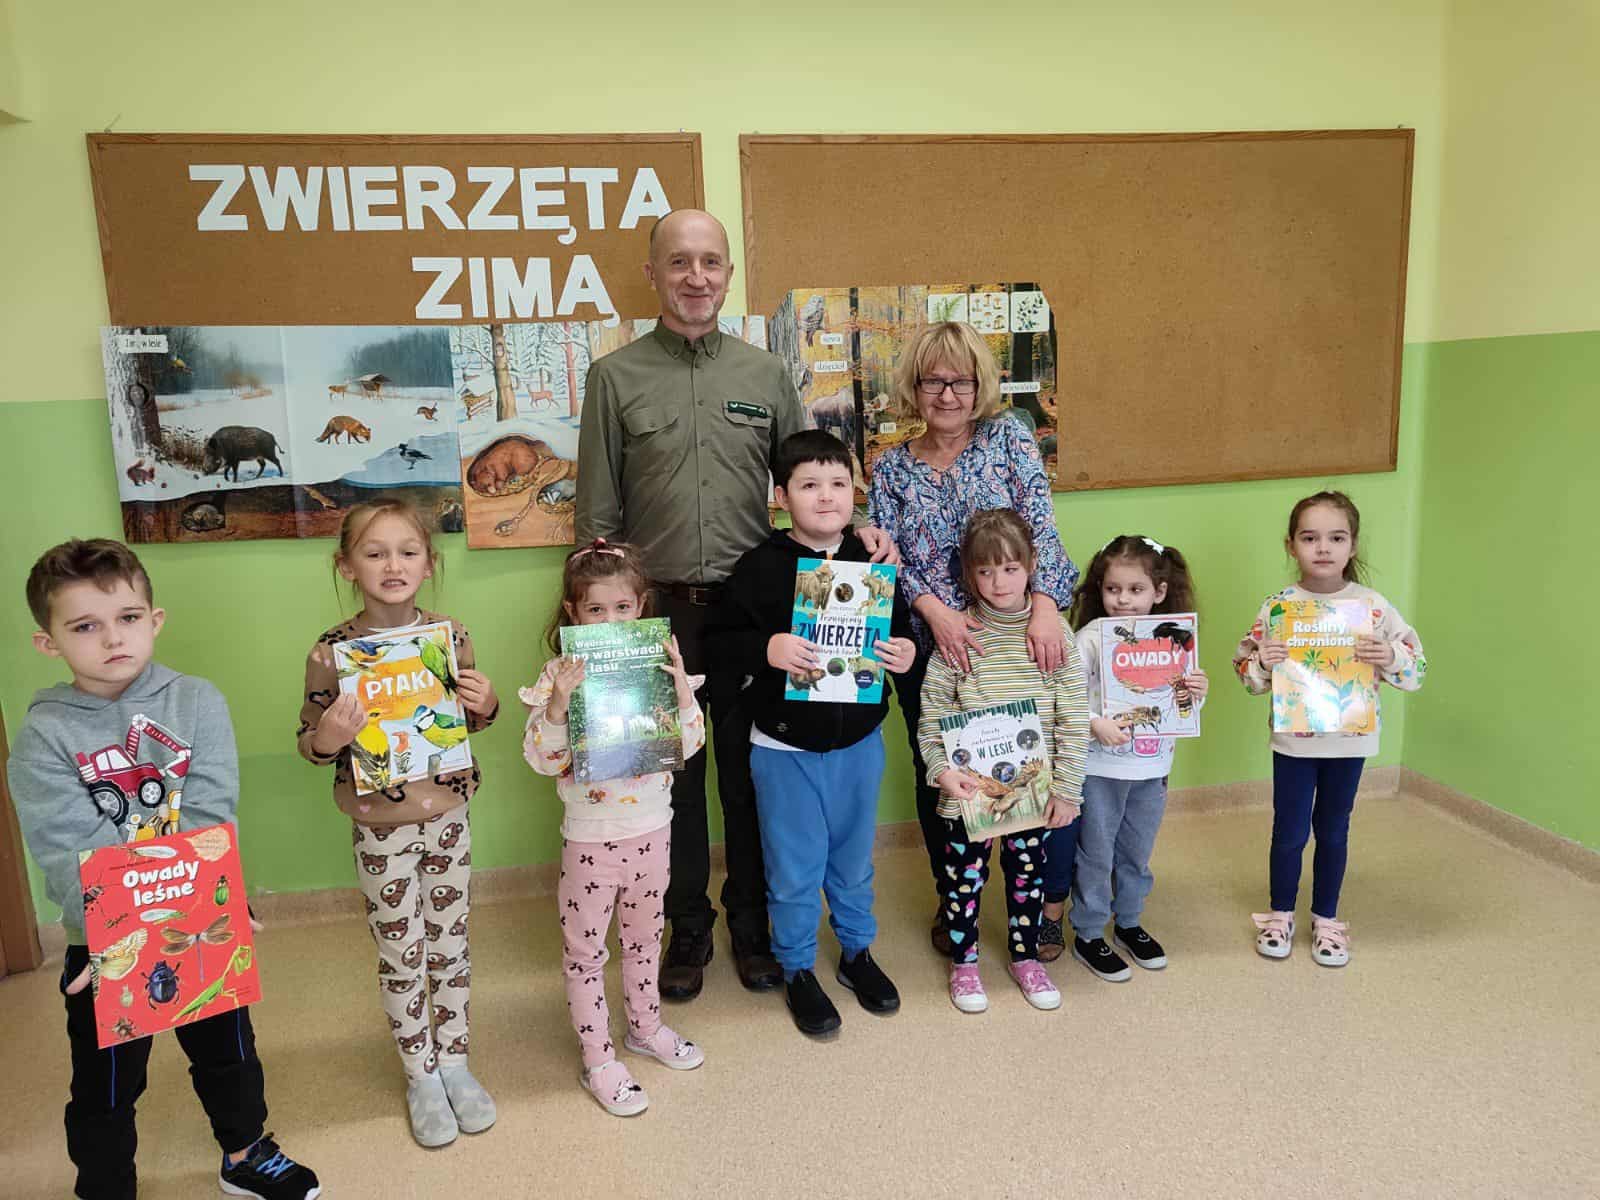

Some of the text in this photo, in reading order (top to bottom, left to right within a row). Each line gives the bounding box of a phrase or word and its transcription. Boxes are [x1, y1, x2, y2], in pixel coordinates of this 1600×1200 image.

[189, 164, 673, 245] ZWIERZĘTA
[411, 254, 620, 328] ZIMĄ
[592, 642, 664, 661] warstwach
[1286, 634, 1356, 648] chronione
[1115, 649, 1183, 668] OWADY
[365, 668, 435, 701] PTAKI
[976, 741, 1015, 760] W LESIE
[122, 860, 200, 889] Owady
[133, 882, 195, 908] leśne
